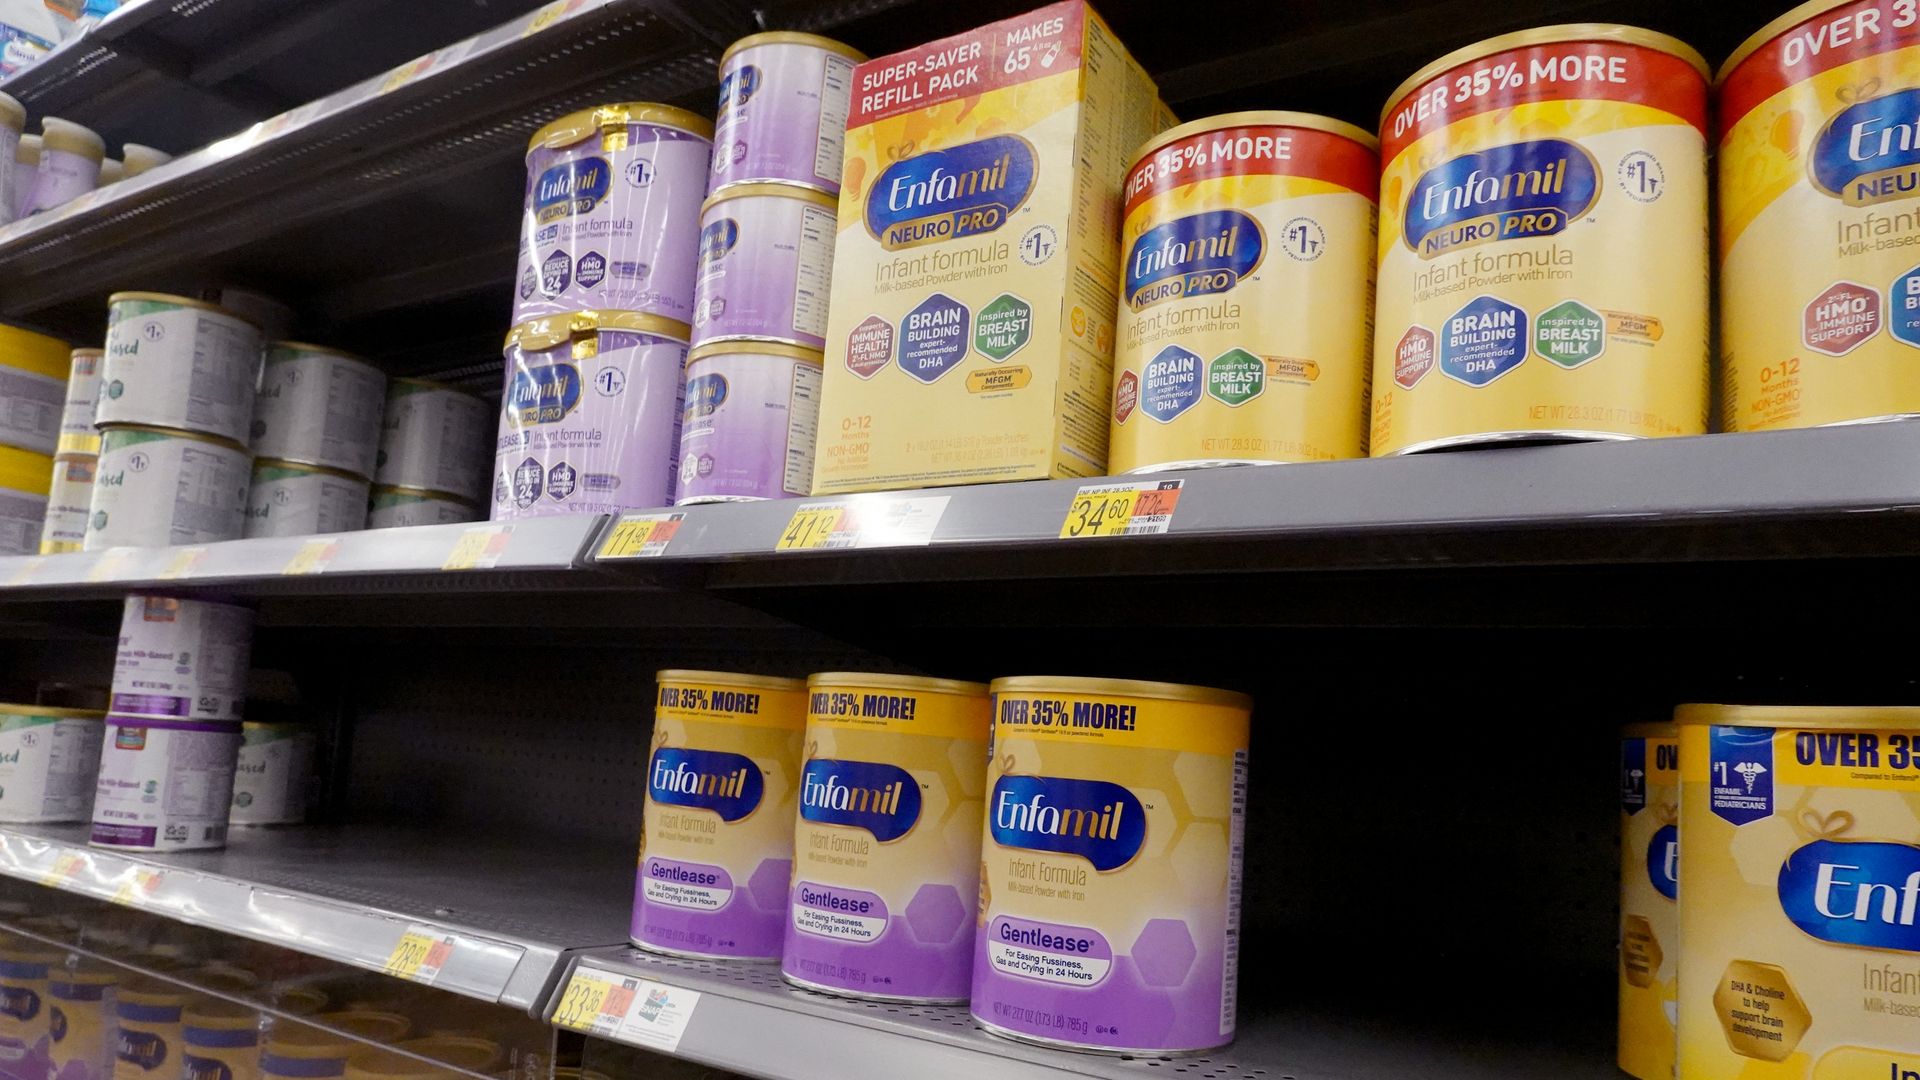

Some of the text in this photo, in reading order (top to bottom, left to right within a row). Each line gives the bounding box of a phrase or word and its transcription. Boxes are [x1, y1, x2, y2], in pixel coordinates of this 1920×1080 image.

[1006, 17, 1064, 47] MAKES
[1783, 8, 1881, 67] OVER
[861, 41, 982, 93] SUPER-SAVER
[1003, 46, 1032, 74] 65
[861, 65, 979, 115] REFILL PACK
[1394, 55, 1627, 138] OVER 35% MORE
[1125, 136, 1292, 206] OVER 35% MORE
[1627, 161, 1646, 193] #1
[888, 153, 1010, 212] Enfamil
[1423, 158, 1567, 221] Enfamil
[890, 206, 999, 246] NEURO PRO
[1425, 212, 1557, 253] NEURO PRO
[1026, 232, 1041, 259] #1
[1289, 225, 1307, 253] #1
[875, 249, 930, 282] Infant
[932, 239, 1010, 271] formula
[1136, 226, 1238, 279] Enfamil
[581, 261, 601, 270] HMO
[1413, 244, 1573, 292] Infant formula
[547, 277, 562, 291] 24
[874, 263, 1008, 296] Milk-based Powder with Iron
[1413, 267, 1573, 304] Milk-based Powder with Iron
[1135, 273, 1229, 308] NEURO PRO
[910, 308, 960, 330] BRAIN
[980, 307, 1028, 322] inspired by
[1816, 297, 1868, 321] HMO
[978, 318, 1028, 336] BREAST
[1127, 300, 1241, 341] Infant formula
[1161, 320, 1240, 341] Powder Iron
[1452, 309, 1515, 334] BRAIN
[1541, 316, 1587, 329] inspired
[1588, 317, 1600, 329] by
[1820, 311, 1875, 331] IMMUNE
[852, 329, 890, 345] IMMUNE
[908, 325, 960, 342] BUILDING
[986, 334, 1017, 348] MILK
[1450, 328, 1516, 348] BUILDING
[1539, 328, 1600, 342] BREAST
[1811, 322, 1873, 344] SUPPORT
[851, 340, 889, 354] HEALTH
[906, 345, 958, 359] recommended
[919, 340, 946, 349] expert-
[1400, 339, 1427, 360] HMO
[1464, 342, 1498, 354] expert-
[1551, 342, 1590, 355] MILK
[919, 357, 943, 369] DHA
[1401, 350, 1431, 366] IMMUNE
[1450, 347, 1515, 364] recommended
[1149, 357, 1194, 379] BRAIN
[1213, 361, 1249, 374] inspired
[1250, 362, 1261, 372] by
[1396, 360, 1429, 379] SUPPORT
[1466, 360, 1497, 373] DHA
[1760, 357, 1800, 383] 0-12
[985, 375, 1011, 384] MFGM
[1147, 373, 1194, 390] BUILDING
[1211, 371, 1261, 384] BREAST
[1761, 378, 1799, 395] Months
[1147, 389, 1193, 403] recommended
[1157, 385, 1181, 395] expert-
[1220, 383, 1251, 395] MILK
[1157, 399, 1179, 411] DHA
[842, 415, 872, 432] 0-12
[561, 428, 601, 441] formula
[827, 442, 869, 457] NON-GMO
[552, 472, 571, 482] HMO
[520, 485, 533, 499] 24
[681, 689, 708, 710] 35%
[711, 691, 760, 715] MORE!
[831, 693, 859, 716] 35%
[863, 694, 917, 720] MORE!
[1001, 700, 1137, 731] OVER 35% MORE!
[1795, 732, 1879, 767] OVER
[653, 760, 747, 799] Enfamil
[1714, 761, 1727, 785] #1
[804, 772, 903, 816] Enfamil
[680, 815, 716, 834] Formula
[997, 791, 1123, 841] Enfamil
[809, 831, 869, 855] Infant Formula
[651, 862, 717, 885] Gentlease
[1009, 858, 1087, 887] Infant Formula
[662, 884, 711, 898] Easing Fussiness,
[801, 887, 870, 913] Gentlease
[1072, 890, 1085, 901] Iron
[812, 912, 864, 928] Easing Fussiness,
[851, 928, 871, 937] Hours
[996, 955, 1093, 981] Gas and Crying 24 Hours
[1005, 948, 1084, 971] For Easing Fussiness,
[1731, 980, 1785, 1000] DHA Choline
[1752, 999, 1770, 1013] help
[1053, 1013, 1081, 1032] LB) 785
[1731, 1010, 1784, 1028] support brain
[1732, 1022, 1782, 1042] development
